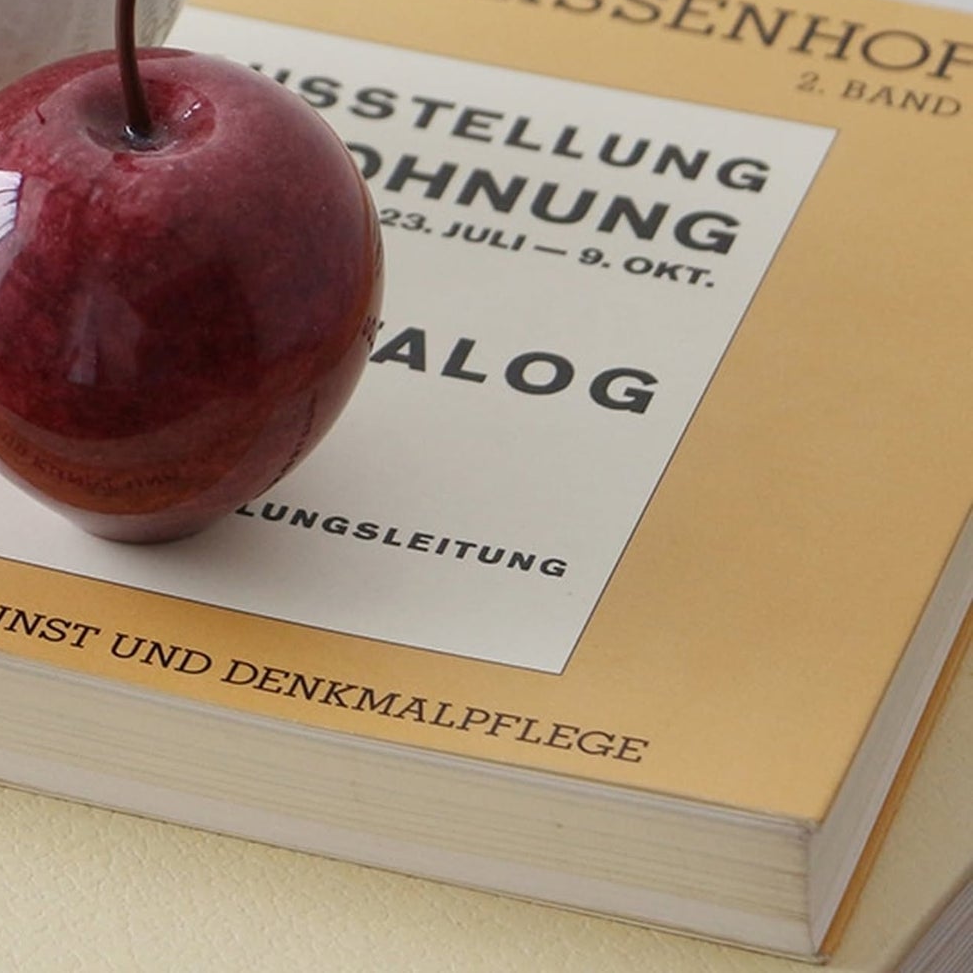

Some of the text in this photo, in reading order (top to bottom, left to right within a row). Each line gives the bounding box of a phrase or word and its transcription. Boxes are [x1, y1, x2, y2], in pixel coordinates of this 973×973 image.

[795, 71, 962, 116] 2. BAND
[382, 209, 431, 233] 23.
[443, 223, 526, 251] JULI
[579, 248, 610, 268] 9.
[623, 257, 714, 287] OKT.
[369, 321, 660, 415] ALOG
[111, 633, 212, 674] UND
[220, 659, 649, 762] DENKMALPFLEGE
